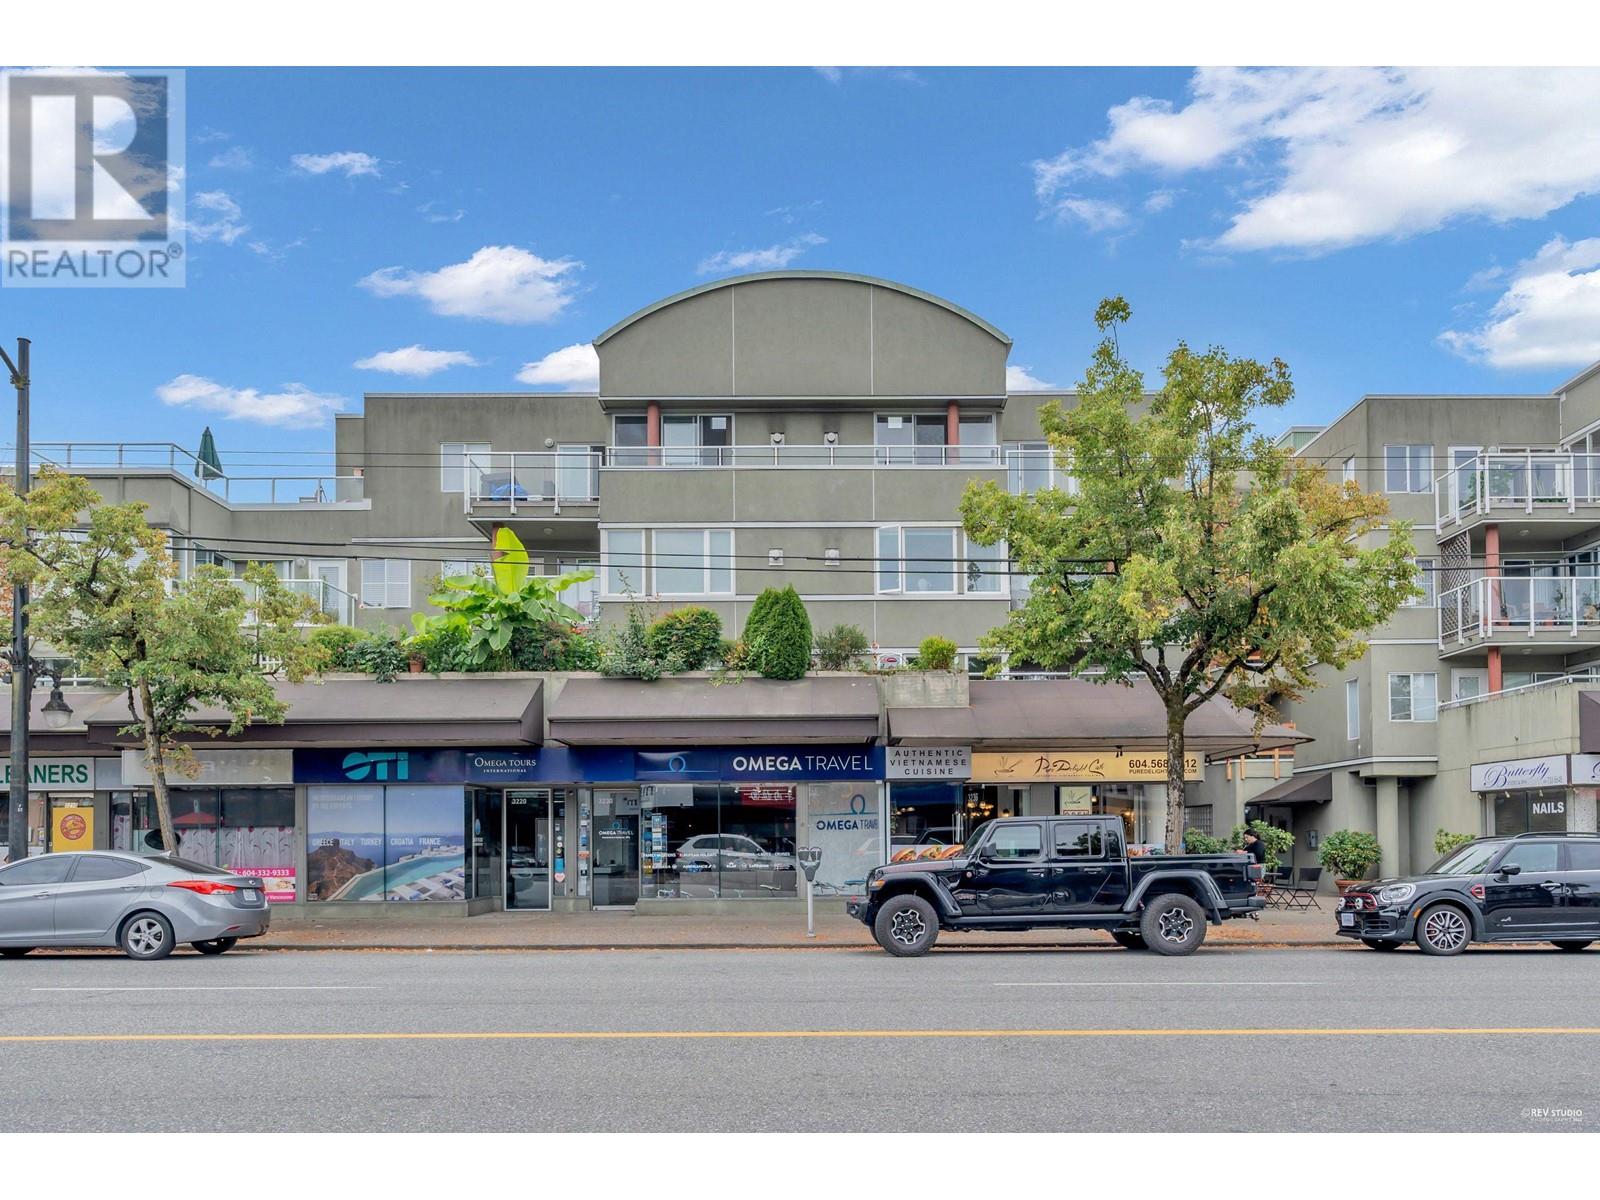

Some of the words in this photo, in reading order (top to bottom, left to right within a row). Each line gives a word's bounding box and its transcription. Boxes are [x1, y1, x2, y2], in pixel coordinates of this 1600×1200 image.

[894, 749, 964, 757] AUTHENTIC
[508, 759, 537, 767] TOURS
[733, 756, 803, 771] OMEGA
[805, 756, 874, 771] TRAVEL
[890, 758, 967, 766] VIETNAMESE
[1129, 759, 1197, 768] 604.56812
[1483, 762, 1550, 788] Butterfly
[1532, 801, 1565, 814] NAILS
[816, 820, 859, 831] OMEGA
[312, 838, 334, 847] GREECE
[339, 838, 354, 846] ITALY
[360, 838, 382, 846] TURKEY
[390, 838, 414, 846] CROATIA
[419, 837, 441, 845] FRANCE
